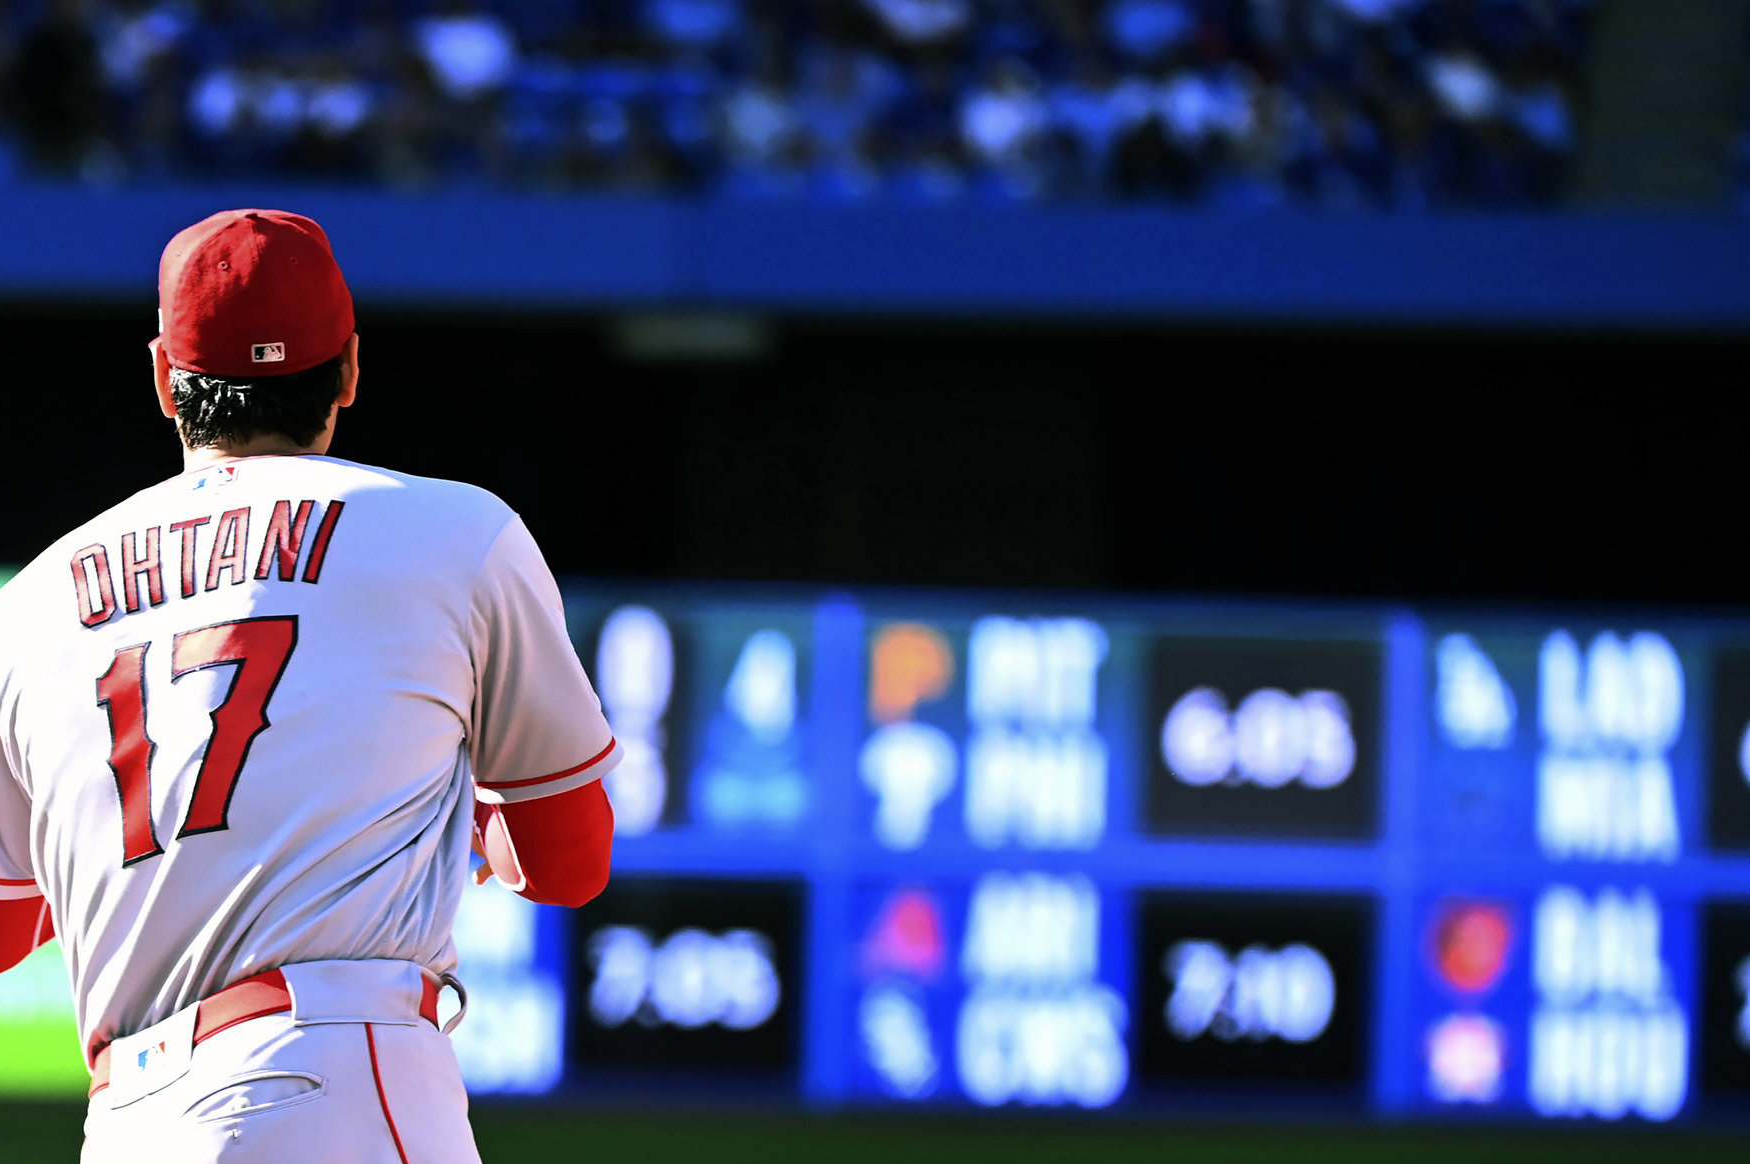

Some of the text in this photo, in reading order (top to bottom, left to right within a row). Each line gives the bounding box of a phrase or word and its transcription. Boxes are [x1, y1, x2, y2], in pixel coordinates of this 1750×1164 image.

[70, 499, 345, 628] OHTANI
[95, 614, 299, 868] 17
[1162, 686, 1356, 789] 6:05
[1538, 630, 1684, 750] LAD
[587, 925, 780, 1029] 7:05
[1163, 938, 1335, 1042] 7:10
